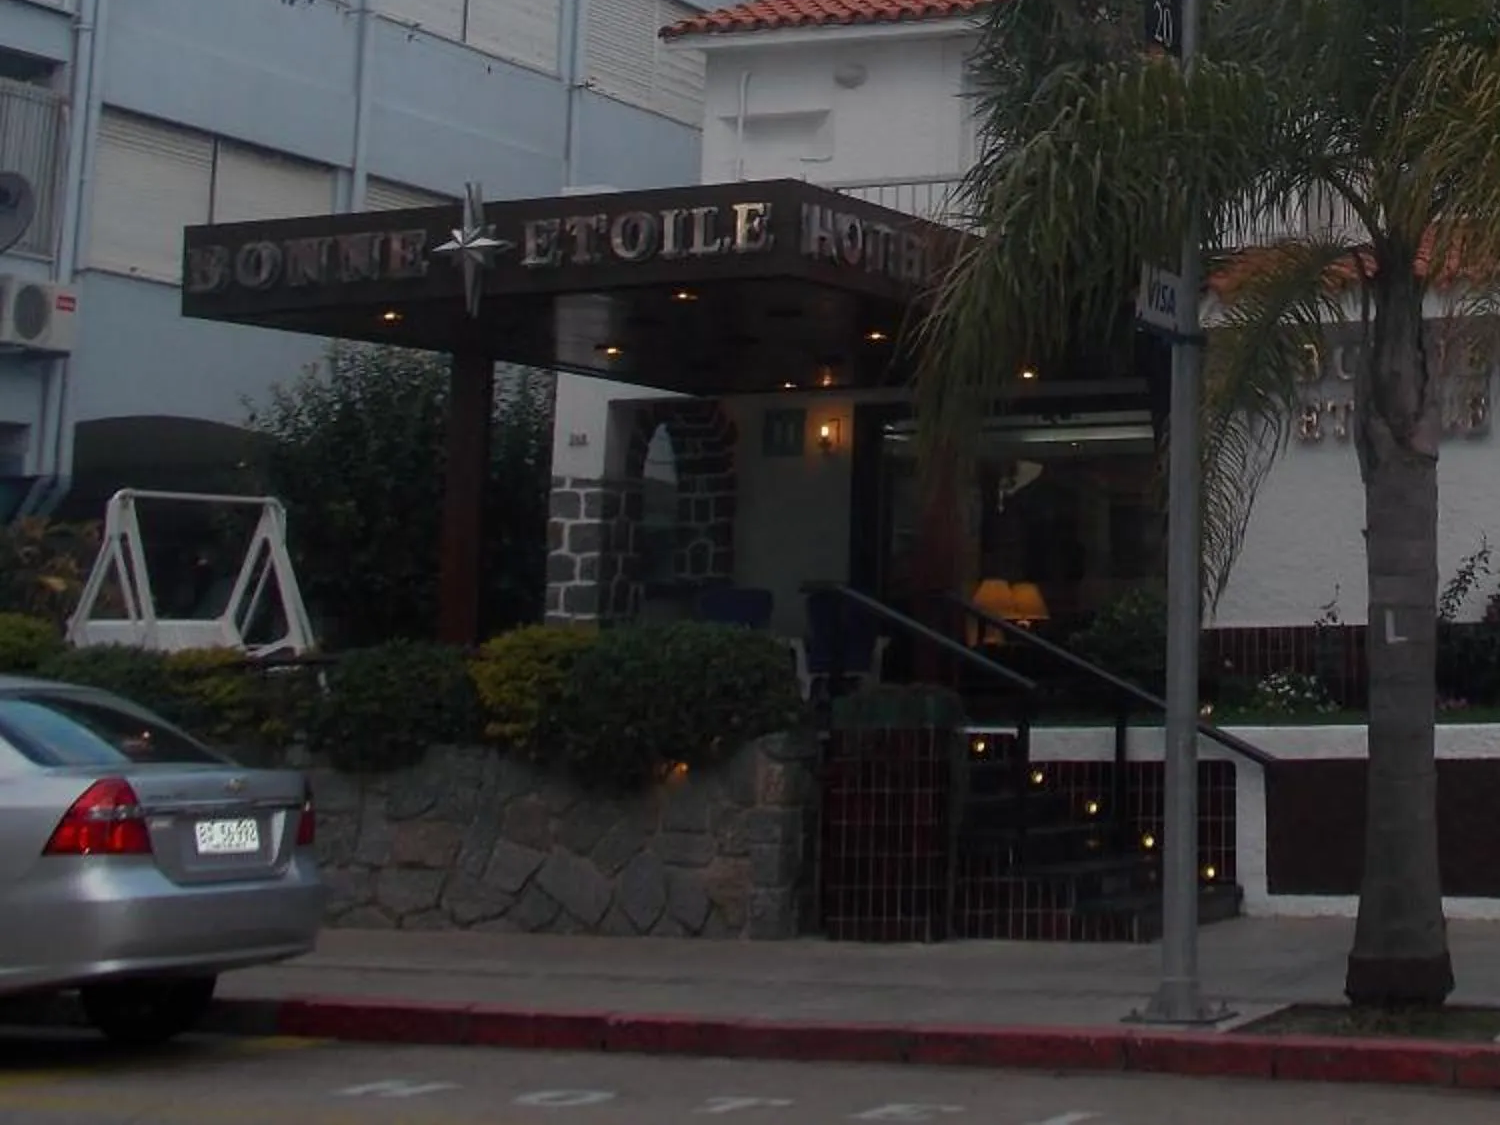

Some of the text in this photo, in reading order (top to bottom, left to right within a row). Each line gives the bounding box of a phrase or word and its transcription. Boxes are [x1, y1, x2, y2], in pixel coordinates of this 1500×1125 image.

[188, 201, 774, 293] BONNE ETOILE
[1148, 278, 1176, 317] VISA
